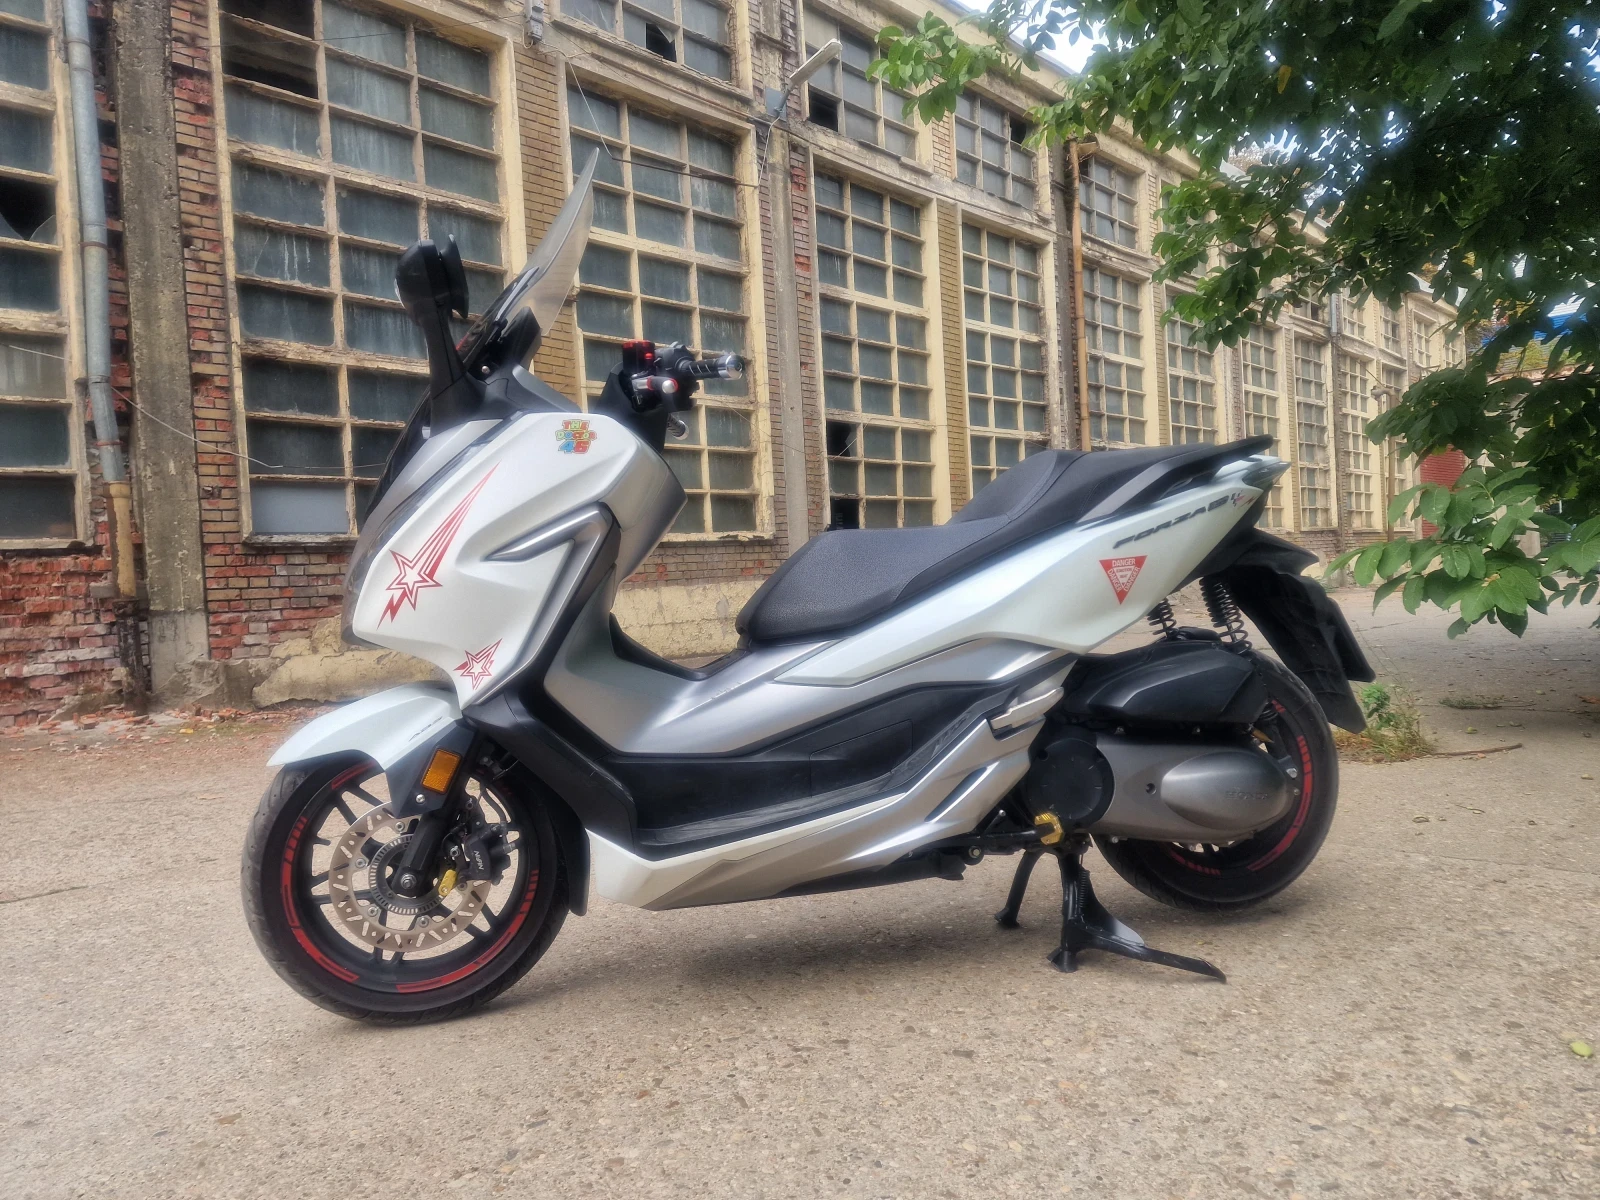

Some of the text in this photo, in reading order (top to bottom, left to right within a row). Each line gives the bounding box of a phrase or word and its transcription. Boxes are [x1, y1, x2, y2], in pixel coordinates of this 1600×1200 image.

[562, 419, 590, 430] THE
[558, 440, 591, 454] 46
[1112, 506, 1207, 549] FORZA
[1112, 558, 1135, 567] DANGER
[1107, 568, 1123, 593] DANGER
[1123, 566, 1141, 592] DANGER
